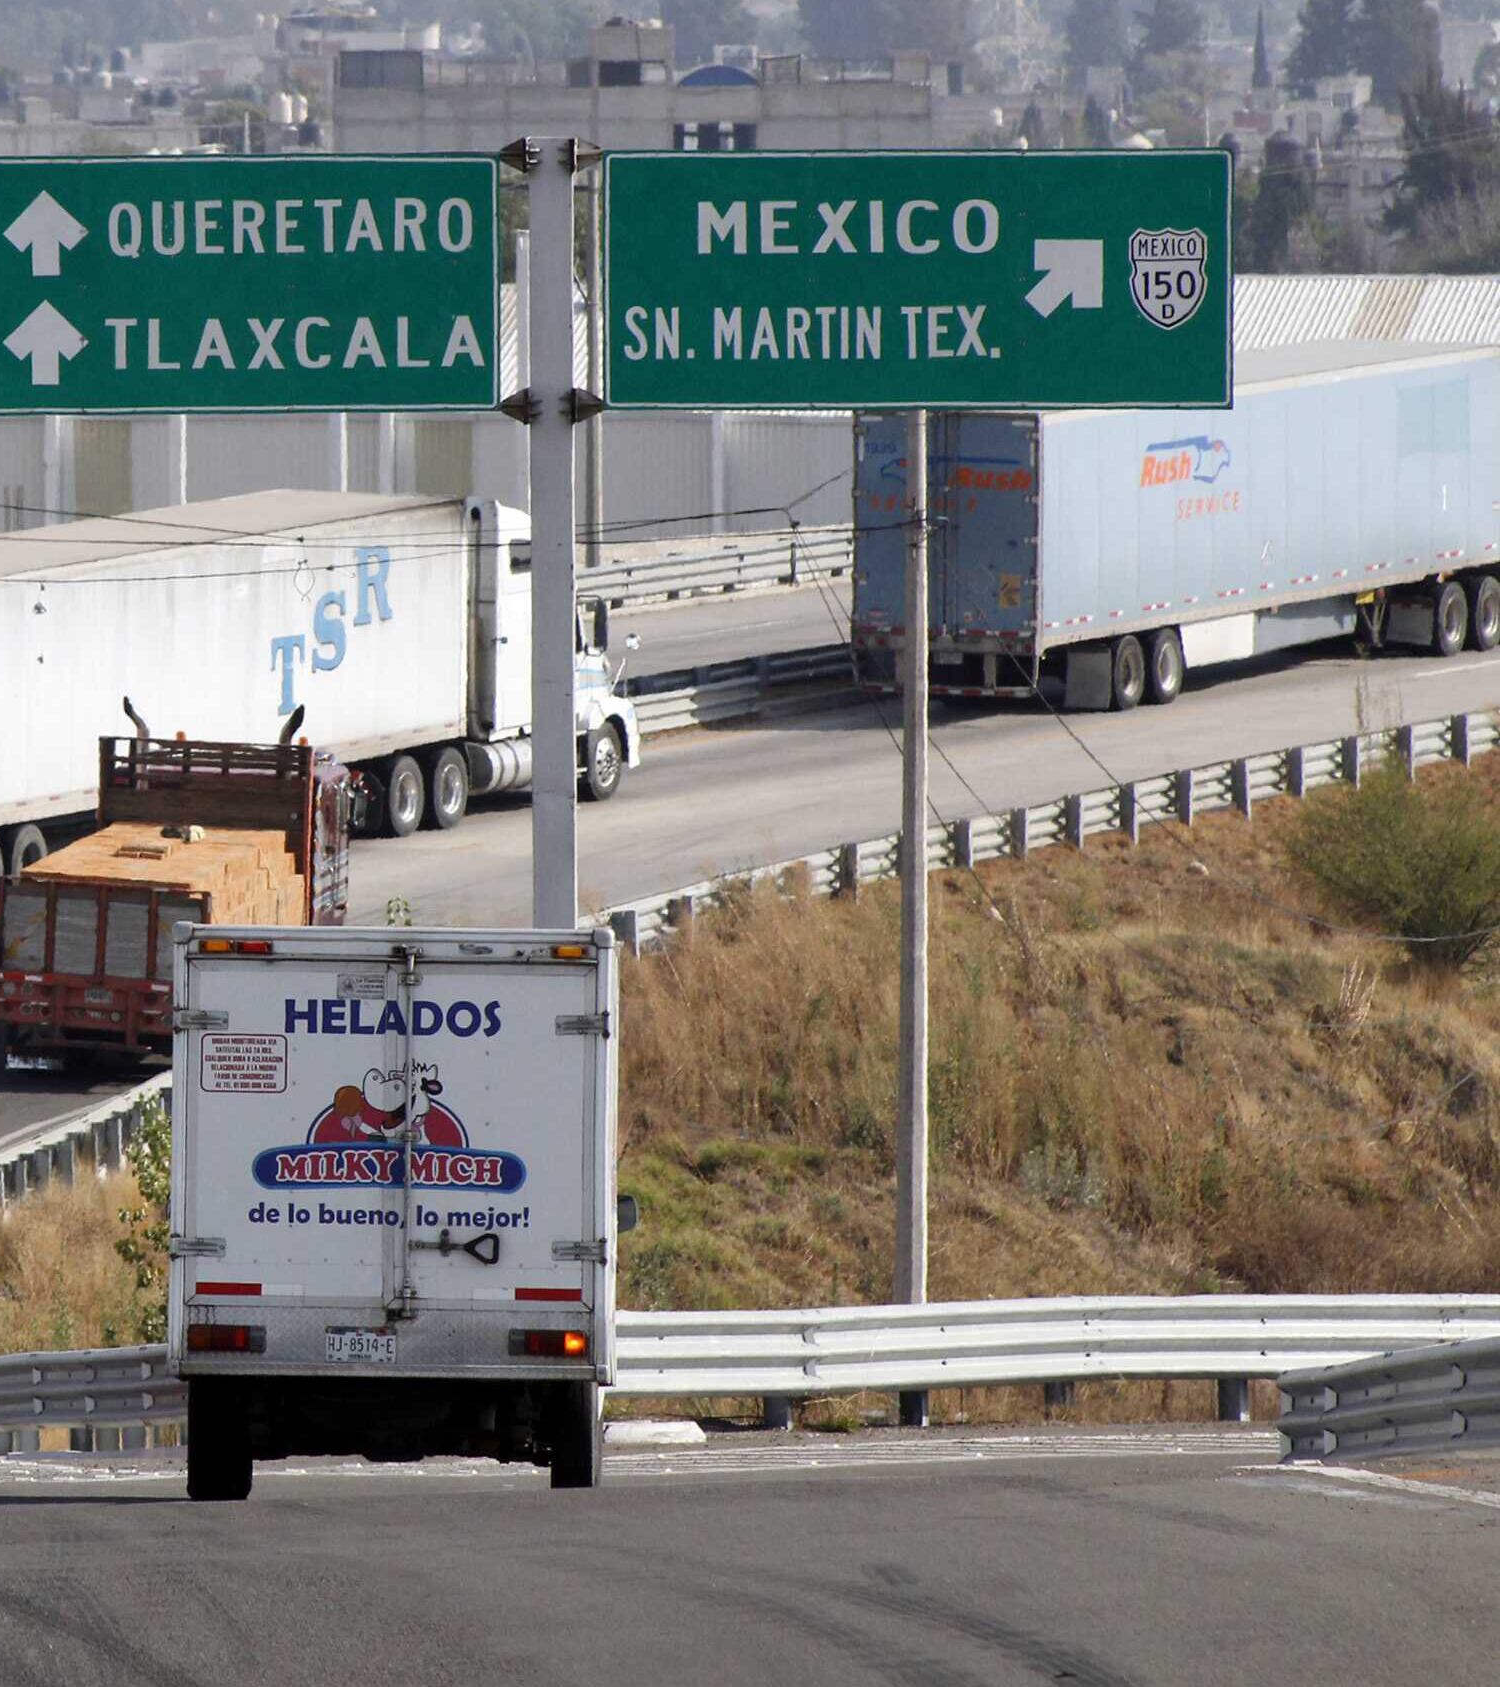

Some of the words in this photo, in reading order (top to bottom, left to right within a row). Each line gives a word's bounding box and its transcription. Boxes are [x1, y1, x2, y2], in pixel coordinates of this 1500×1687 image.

[108, 197, 474, 259] QUERETARO
[697, 199, 1000, 255] MEXICO
[1137, 237, 1198, 258] MEXICO
[1141, 270, 1197, 300] 150
[1161, 303, 1175, 321] D
[104, 316, 485, 371] TLAXCALA
[623, 306, 696, 361] SN.
[713, 306, 882, 361] MARTIN
[901, 304, 1001, 360] TEX.
[1140, 451, 1192, 488] Rush
[1176, 490, 1243, 520] SERVICE
[271, 545, 393, 717] TSR
[283, 999, 501, 1038] HELADOS
[276, 1149, 397, 1185] MILKY
[408, 1151, 503, 1185] MICH
[248, 1203, 279, 1224] de
[288, 1203, 311, 1225] lo
[318, 1204, 405, 1230] bueno,
[416, 1205, 439, 1227] lo
[447, 1206, 531, 1232] mejor!
